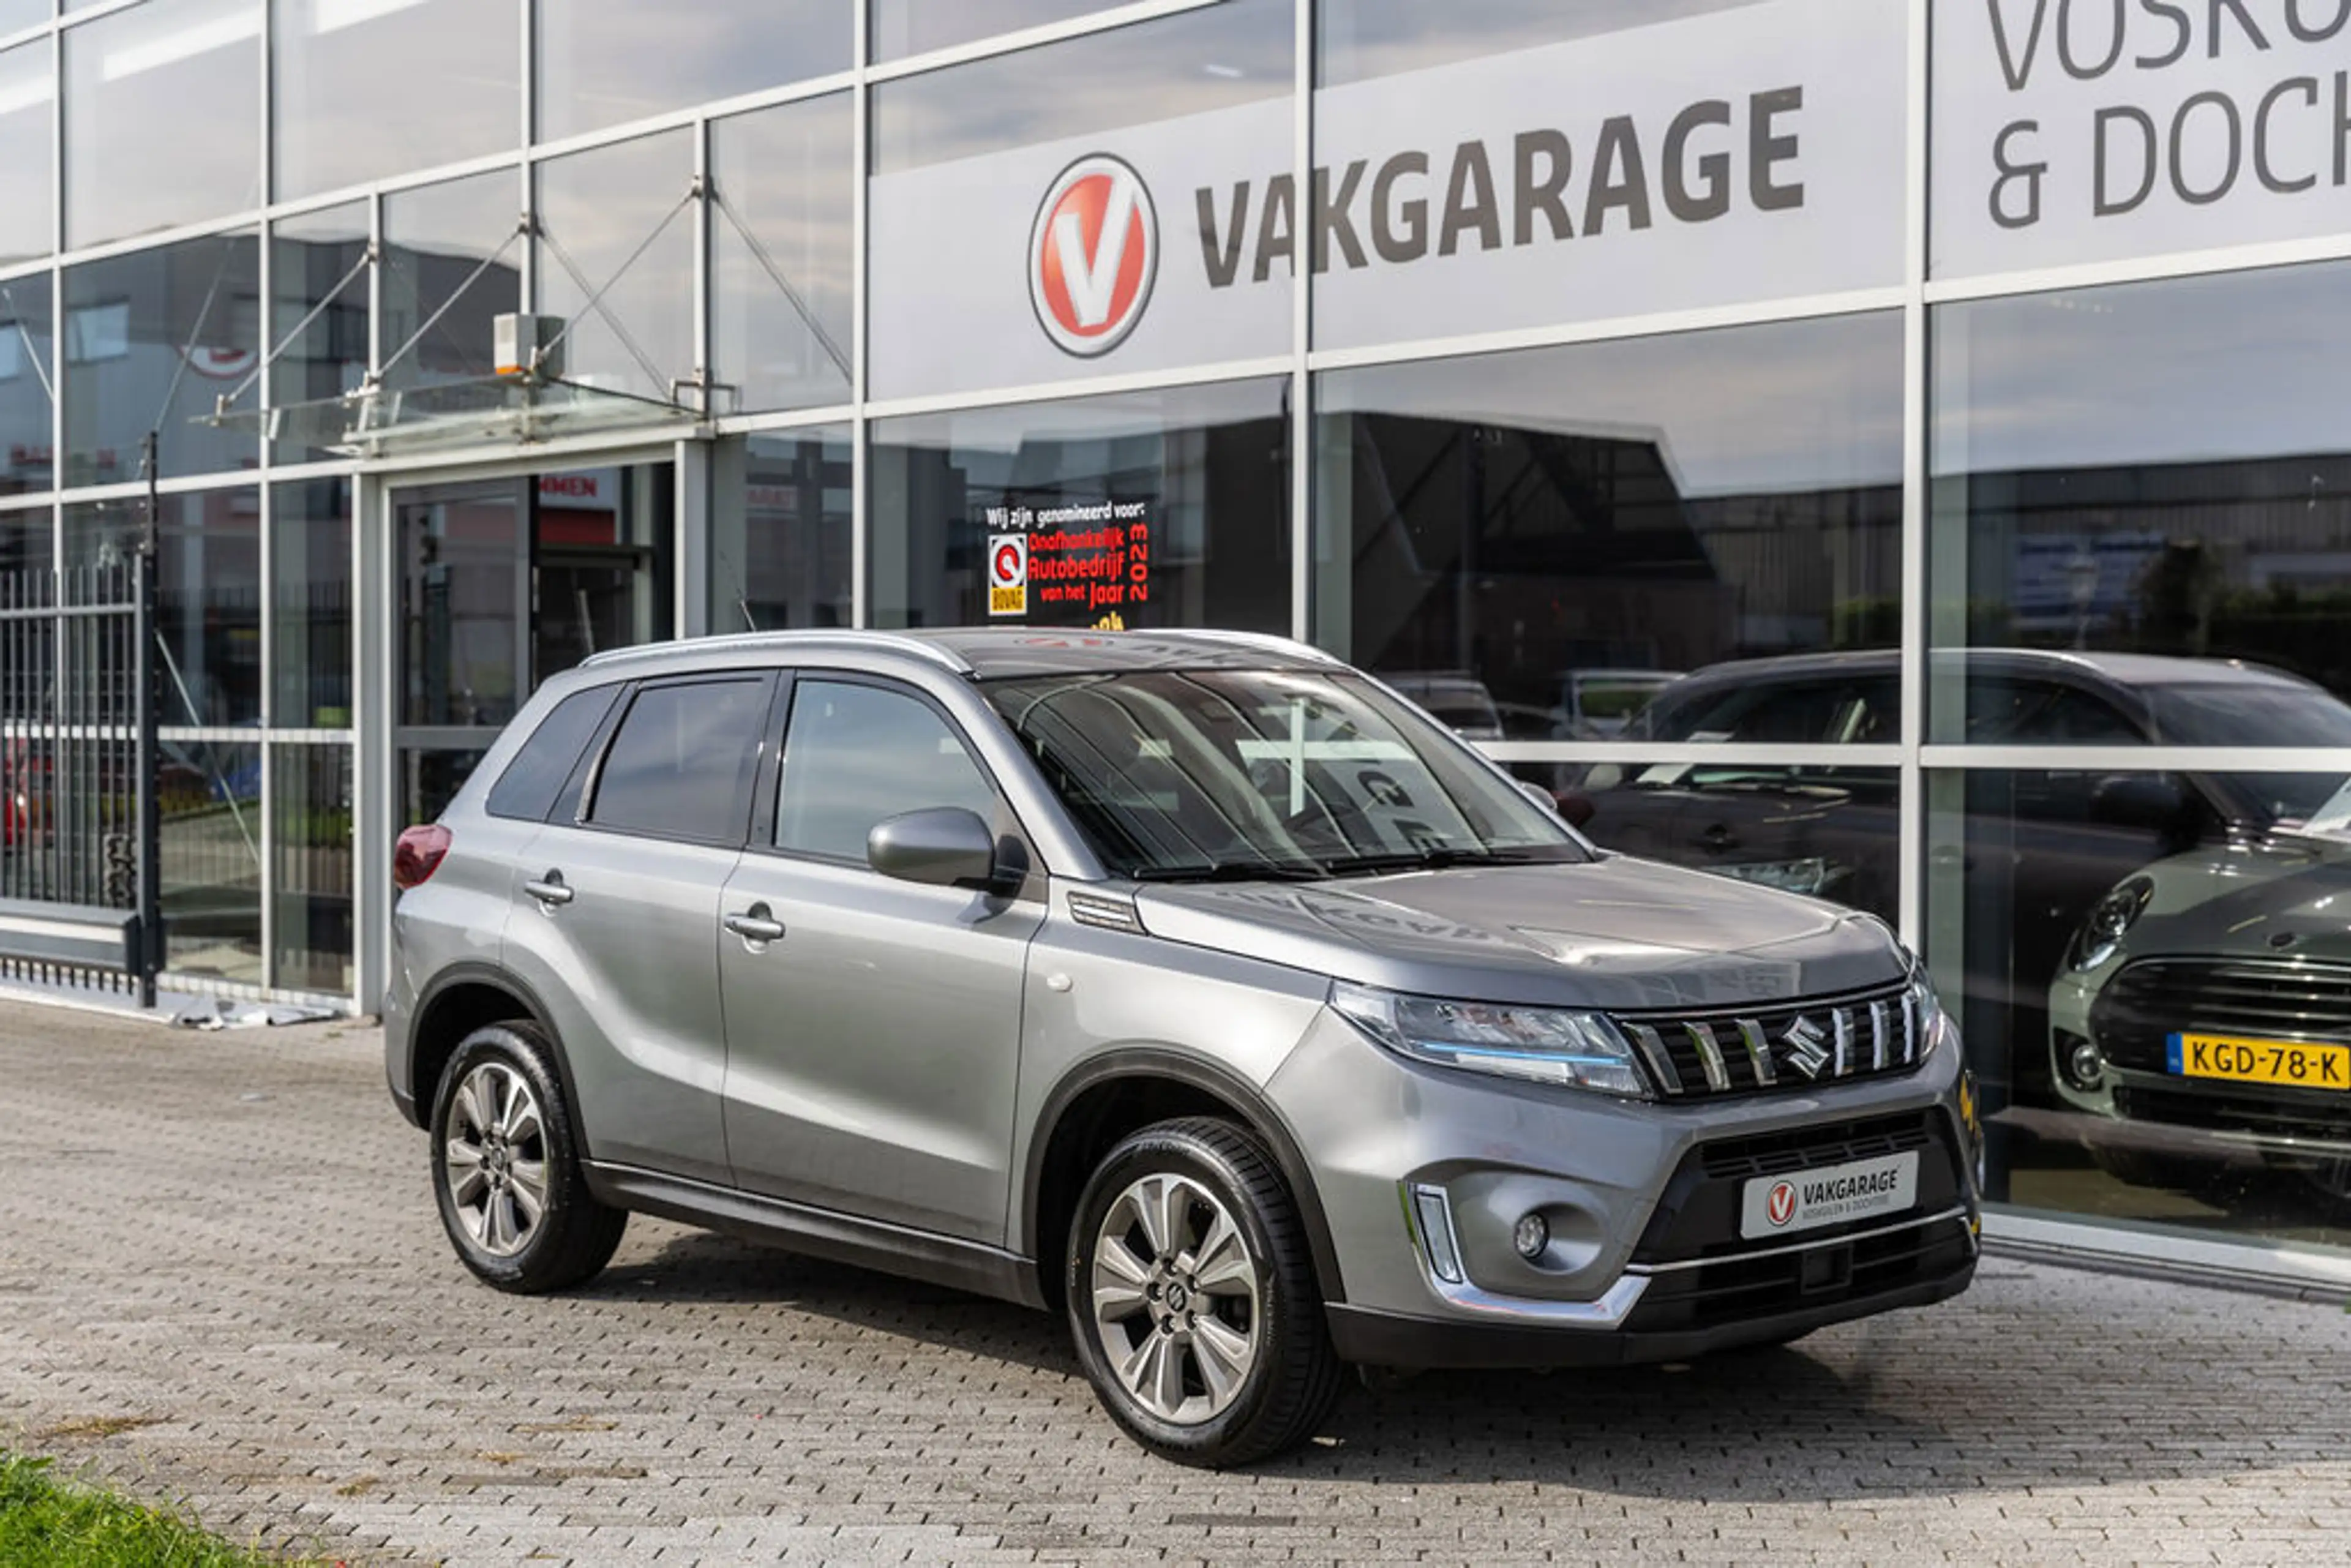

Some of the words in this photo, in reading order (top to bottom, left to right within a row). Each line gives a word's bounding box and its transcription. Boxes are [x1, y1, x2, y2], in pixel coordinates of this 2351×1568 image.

[1194, 85, 1804, 289] VAKGARAGE
[1989, 119, 2048, 229] &
[986, 507, 1008, 530] Wij
[1010, 506, 1033, 529] zijn
[1037, 500, 1112, 529] genomineerd
[1114, 502, 1145, 518] voor:
[1029, 552, 1125, 582] Autobedrijf
[1129, 523, 1149, 601] 2023
[1041, 586, 1063, 602] van
[1066, 583, 1086, 600] het
[1089, 581, 1125, 611] Jaar
[2192, 1041, 2341, 1082] KGD-78-K
[1803, 1169, 1898, 1206] VAKGARAGE
